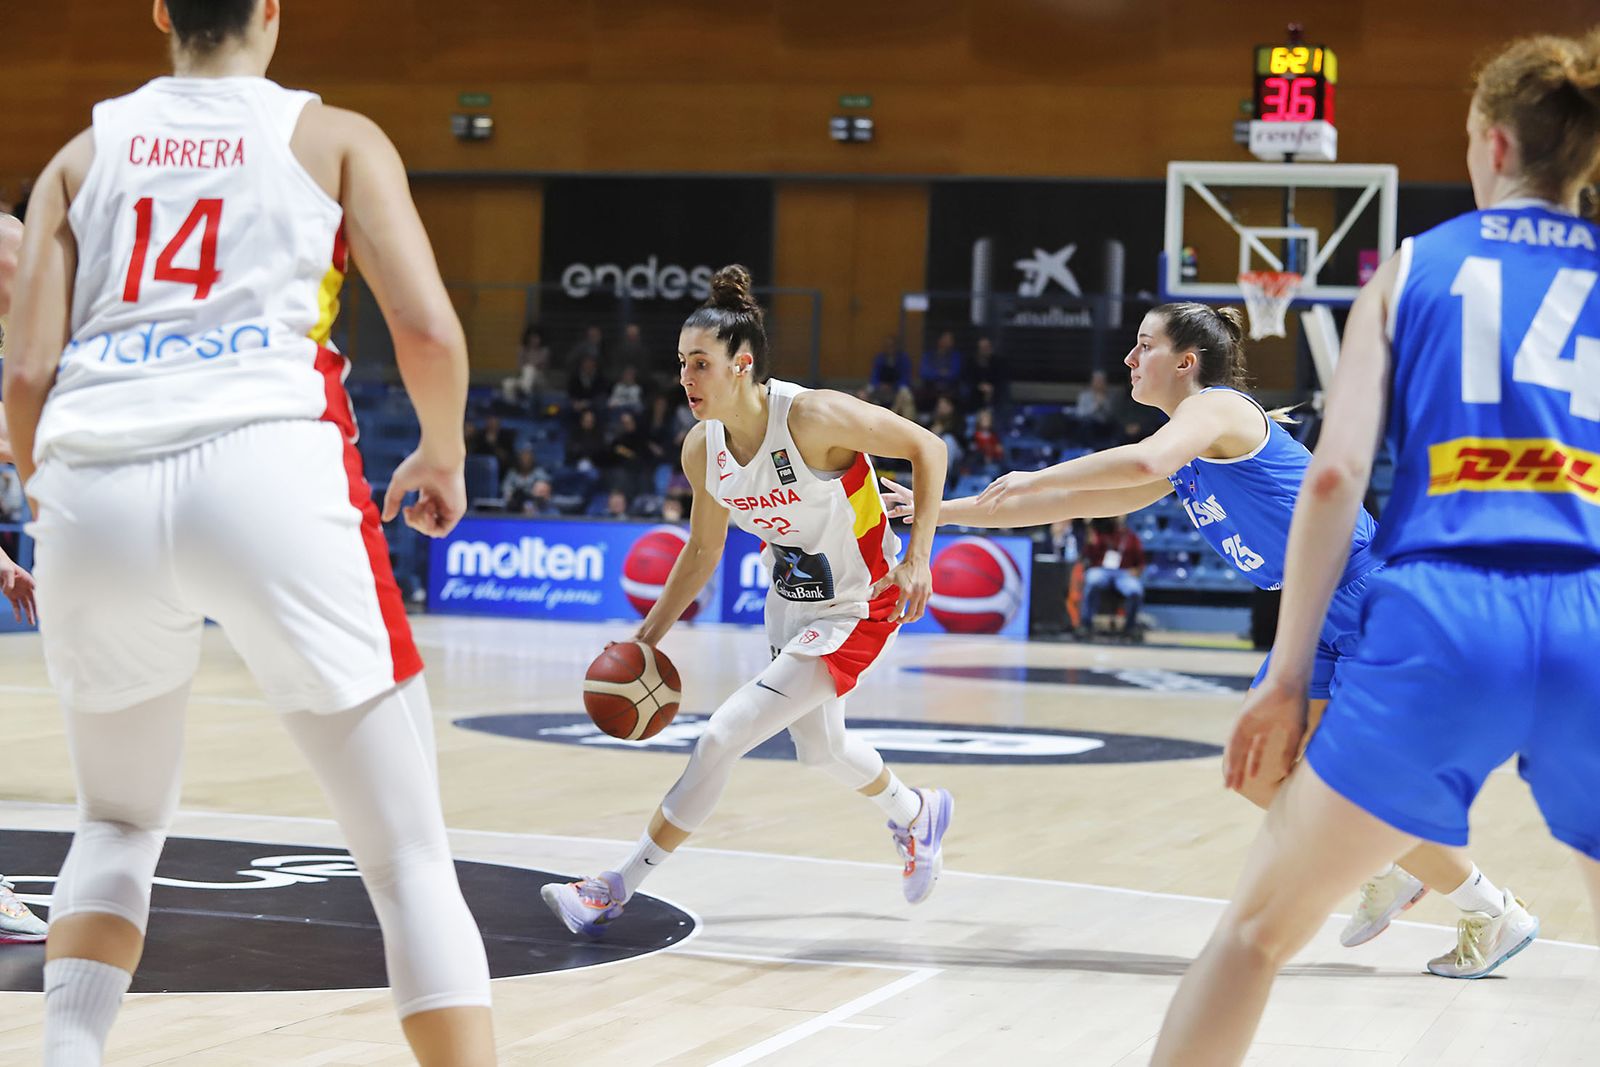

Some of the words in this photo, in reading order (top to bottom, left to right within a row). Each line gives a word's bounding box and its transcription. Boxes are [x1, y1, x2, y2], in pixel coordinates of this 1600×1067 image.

[129, 135, 244, 168] CARRERA
[122, 197, 224, 303] 14
[1480, 214, 1596, 250] SARA
[561, 254, 714, 300] endes
[1450, 255, 1600, 422] 14
[1456, 447, 1599, 494] DHL
[446, 536, 604, 581] molten
[1222, 533, 1265, 572] 25
[440, 577, 473, 600] For
[472, 579, 506, 601] the
[505, 582, 551, 602] real
[545, 589, 603, 610] game
[775, 579, 825, 599] CaixaBank
